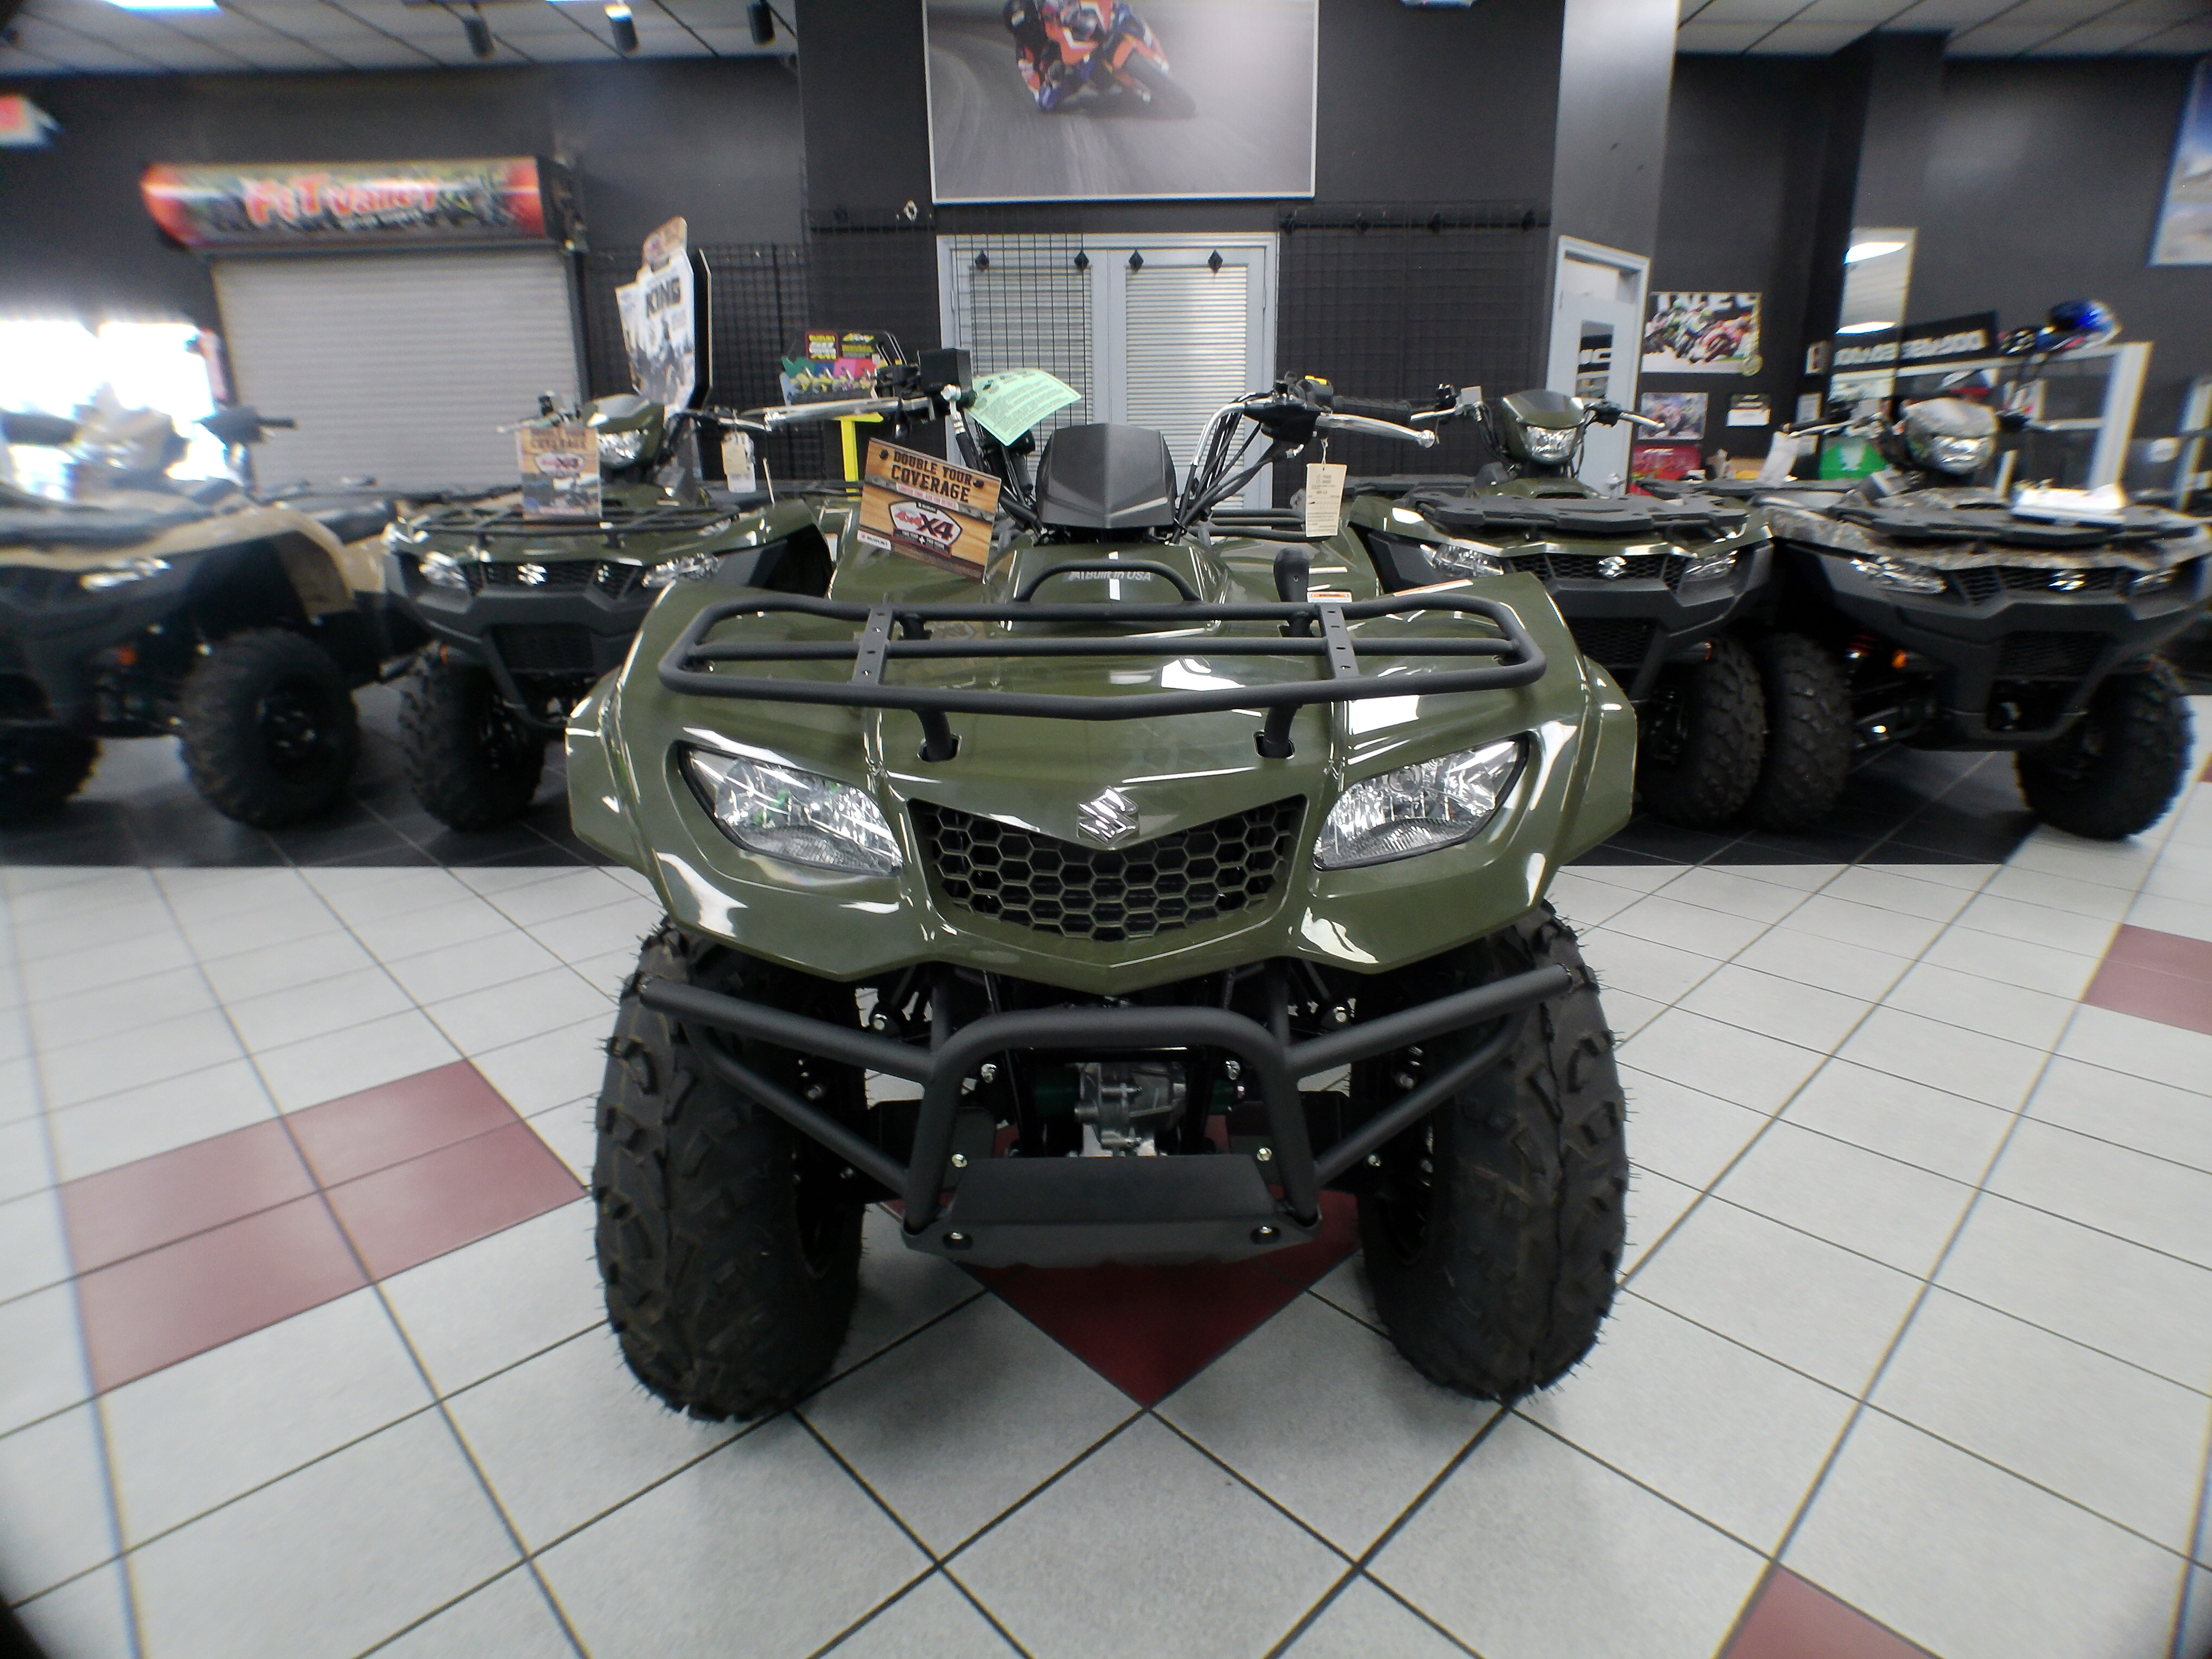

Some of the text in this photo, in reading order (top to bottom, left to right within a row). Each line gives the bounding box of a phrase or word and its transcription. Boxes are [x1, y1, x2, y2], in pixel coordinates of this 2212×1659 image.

[646, 277, 682, 318] KING
[891, 464, 971, 503] COVERAGE
[894, 450, 972, 486] DOUBLE YOUR
[1127, 571, 1152, 581] USA
